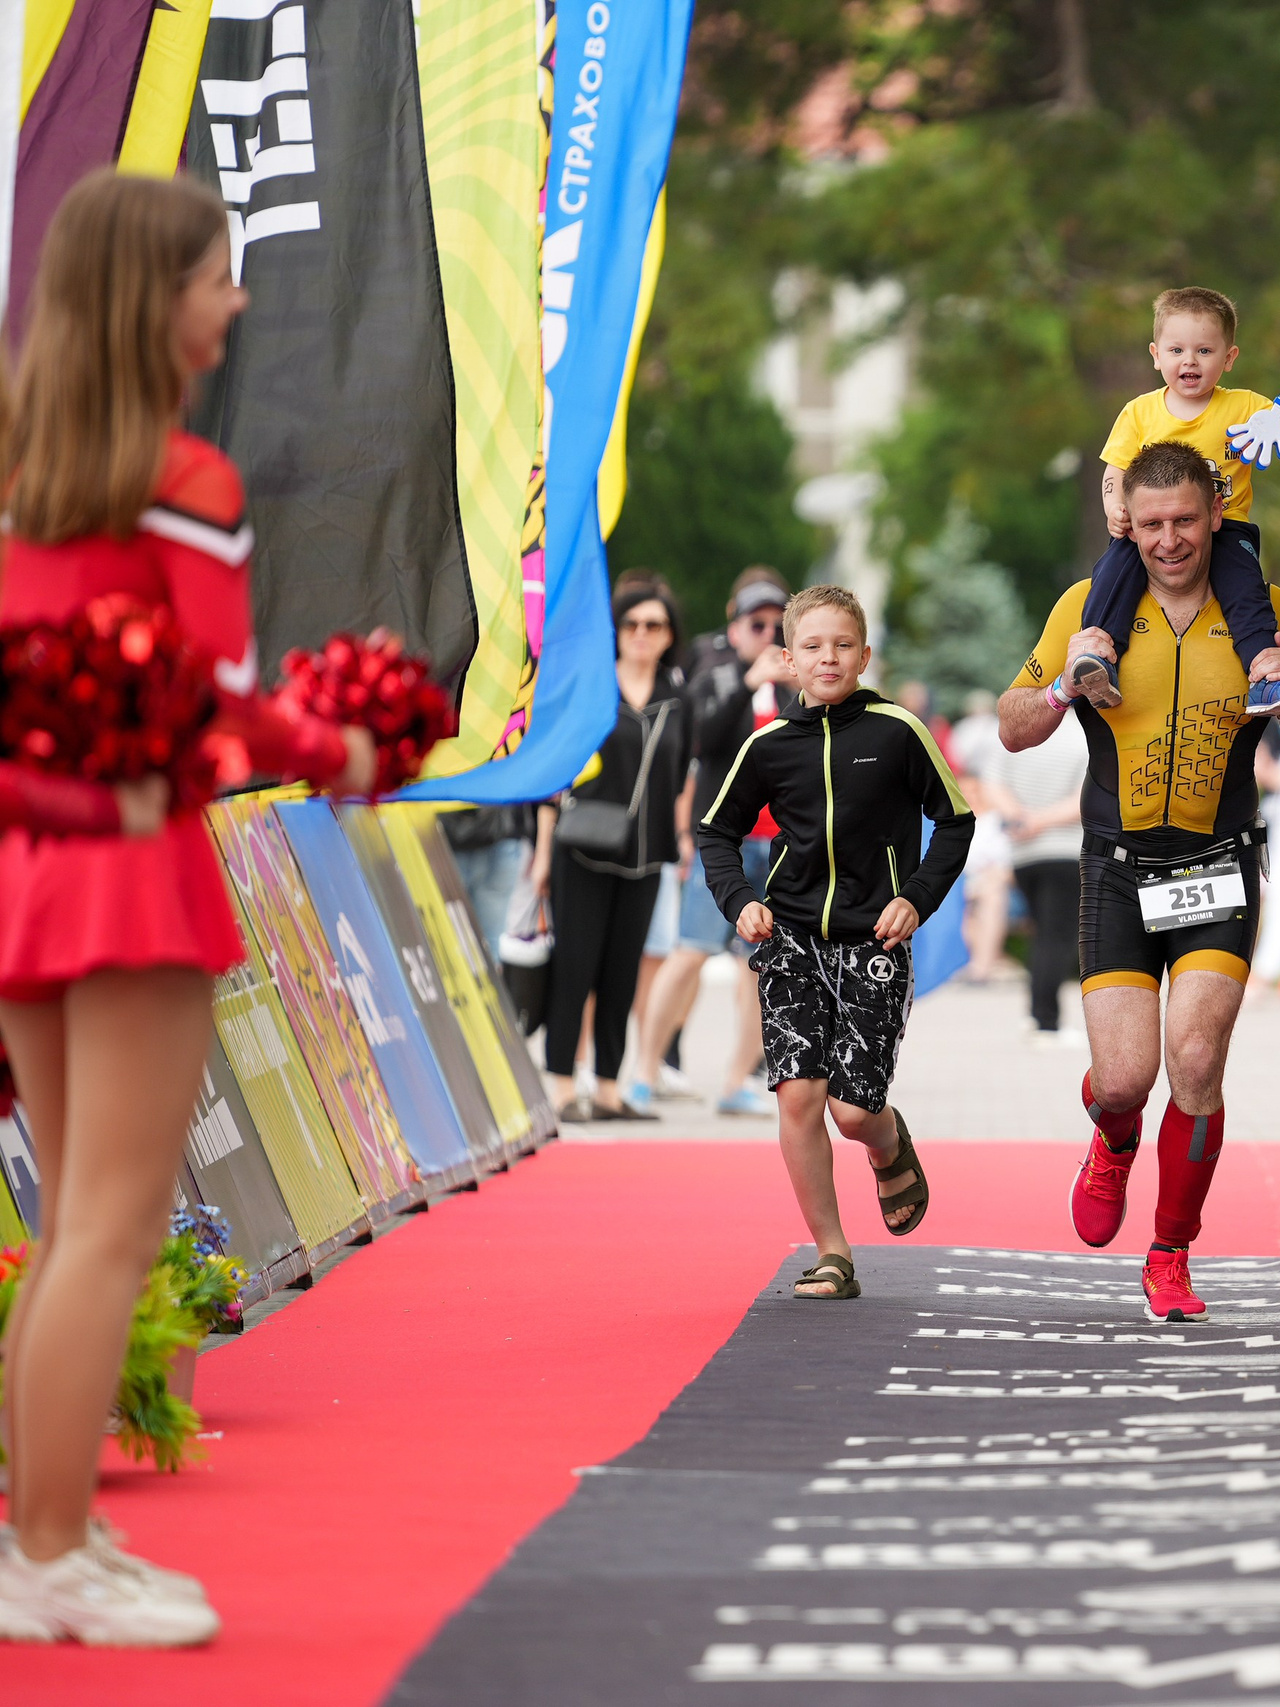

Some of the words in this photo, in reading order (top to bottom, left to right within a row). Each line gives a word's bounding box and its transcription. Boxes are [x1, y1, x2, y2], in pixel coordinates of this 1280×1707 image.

[558, 0, 611, 215] СТРАХОВО
[1168, 883, 1215, 910] 251
[1178, 911, 1213, 923] VLADIMIR
[918, 1327, 1185, 1342] IRON
[885, 1383, 1179, 1396] IRON
